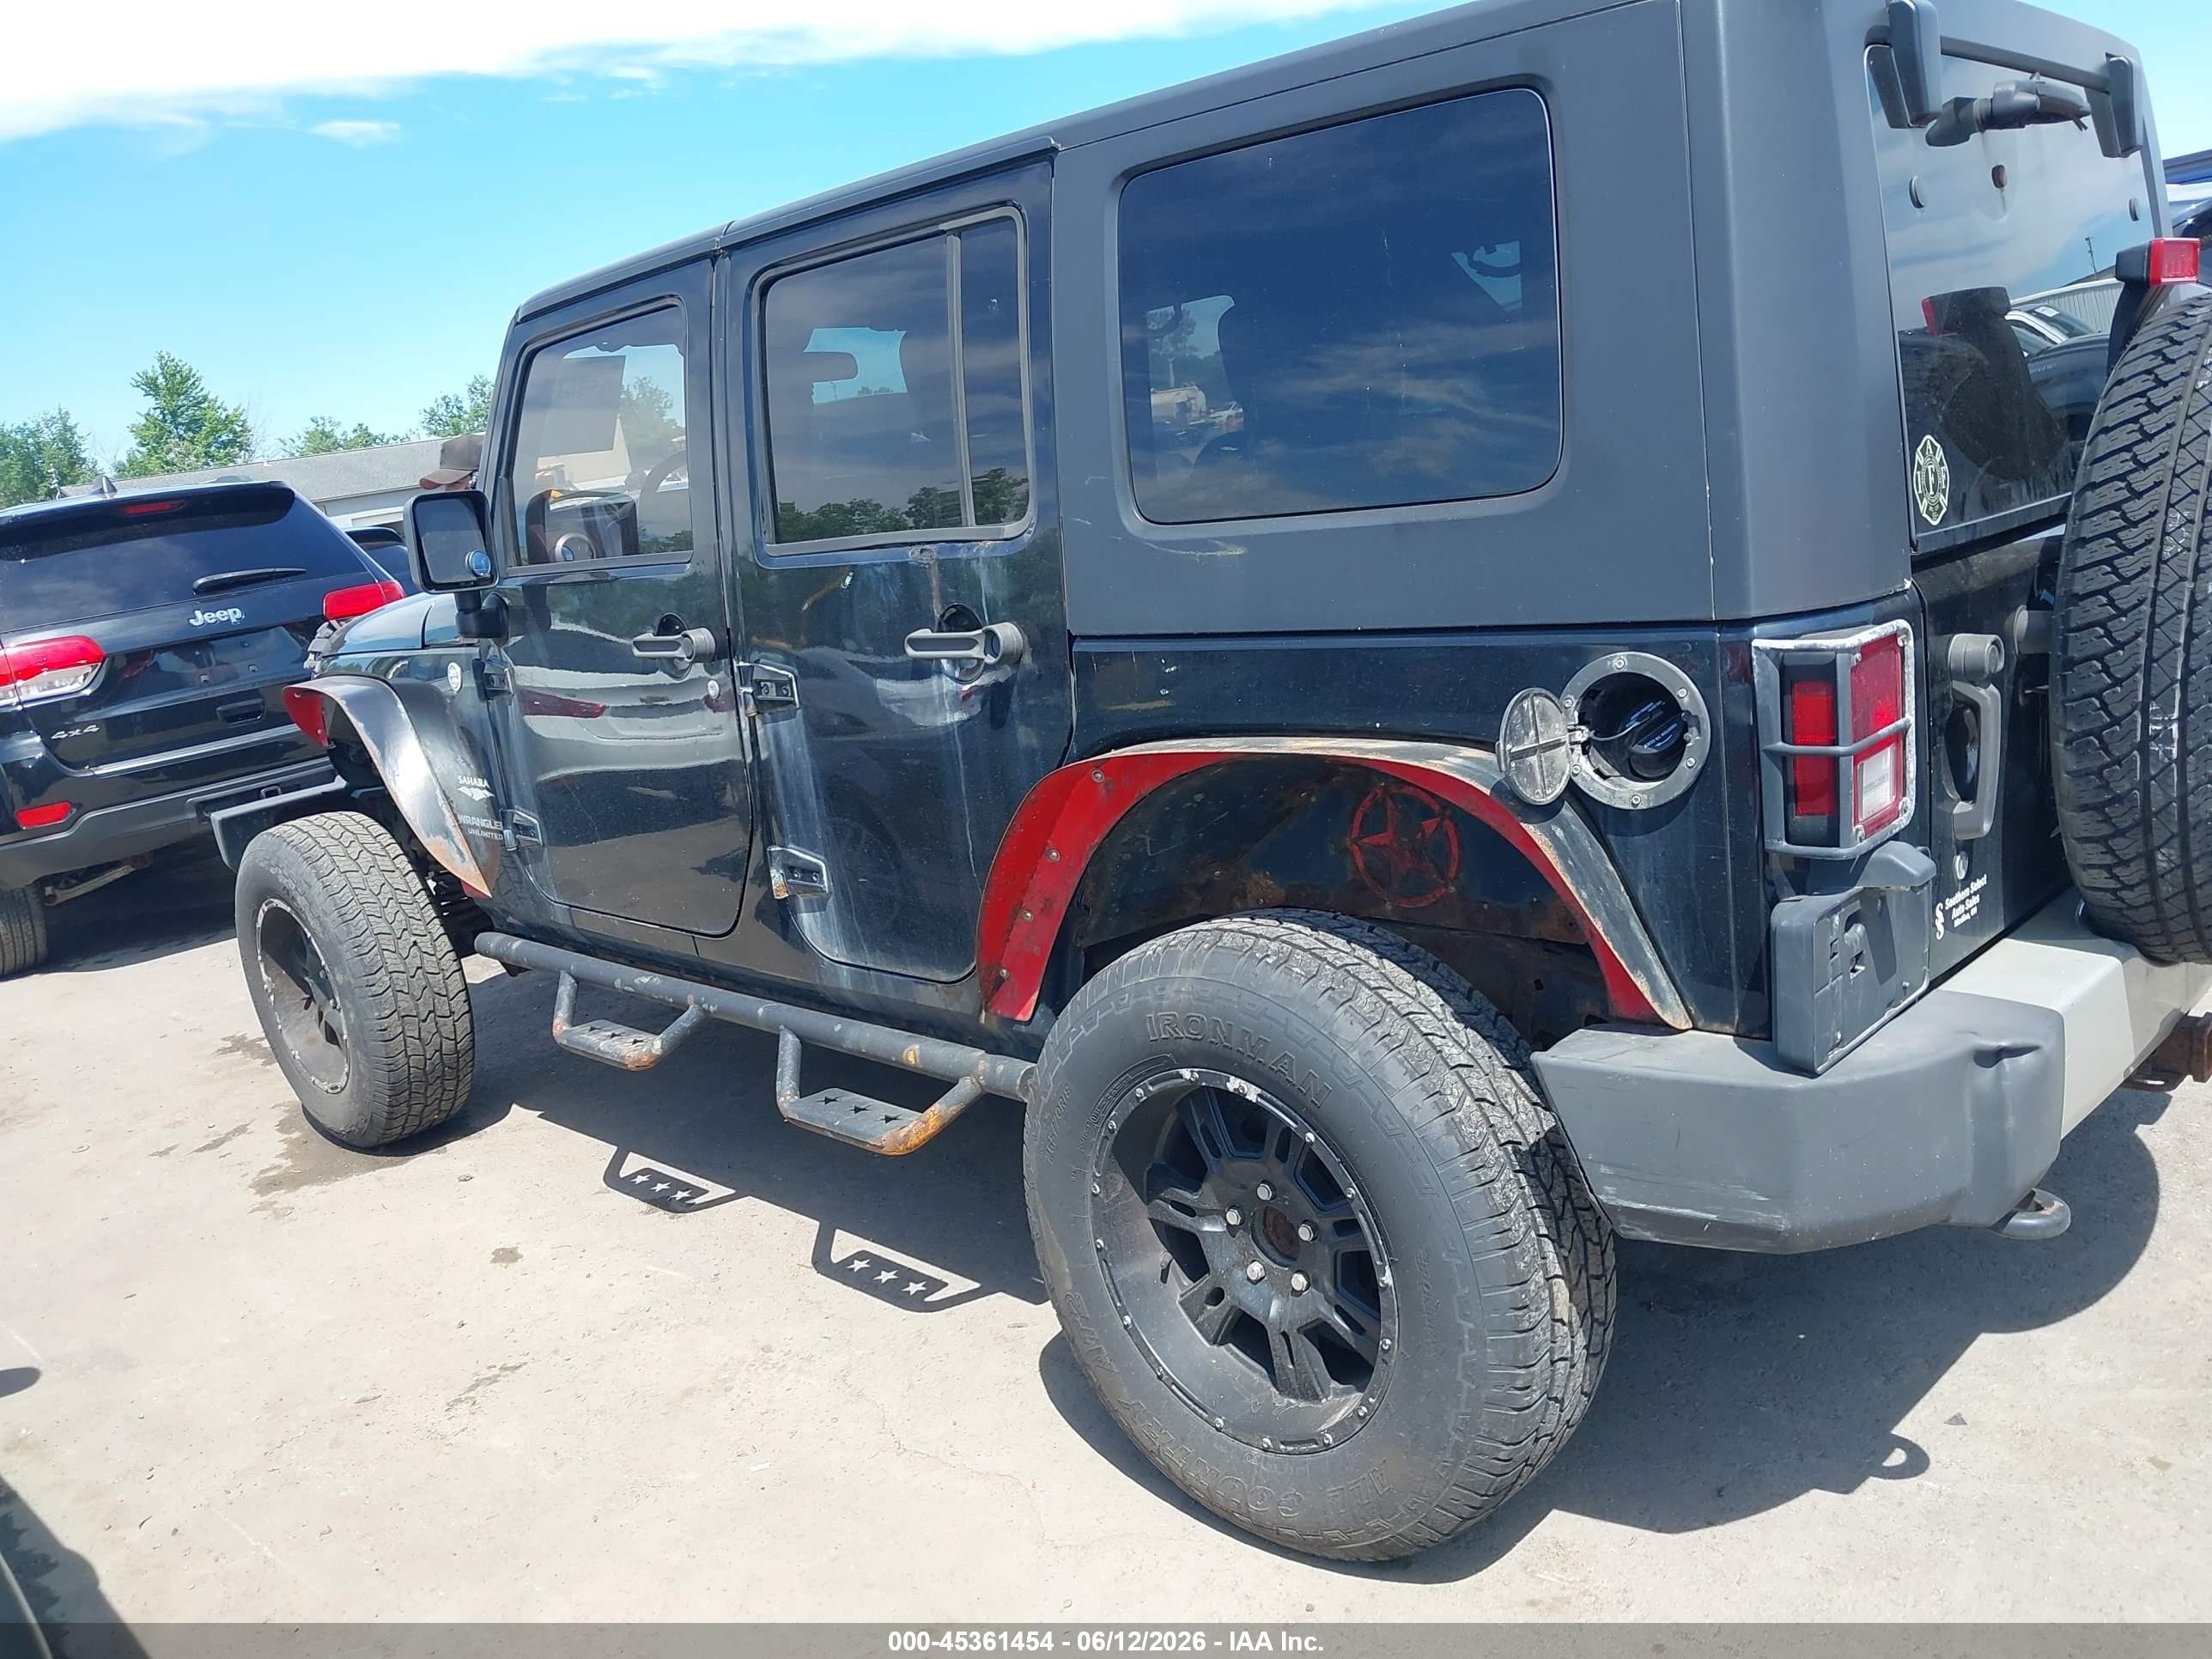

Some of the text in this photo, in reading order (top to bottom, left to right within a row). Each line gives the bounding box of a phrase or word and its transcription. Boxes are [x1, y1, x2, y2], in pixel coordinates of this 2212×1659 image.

[189, 608, 243, 626] Jeep
[458, 775, 490, 789] SAHARA
[468, 828, 503, 840] UNLIMITED
[1945, 873, 1987, 910] Southern Select
[1952, 894, 1980, 920] Auto Sales
[1146, 1012, 1333, 1108] IRONMAN
